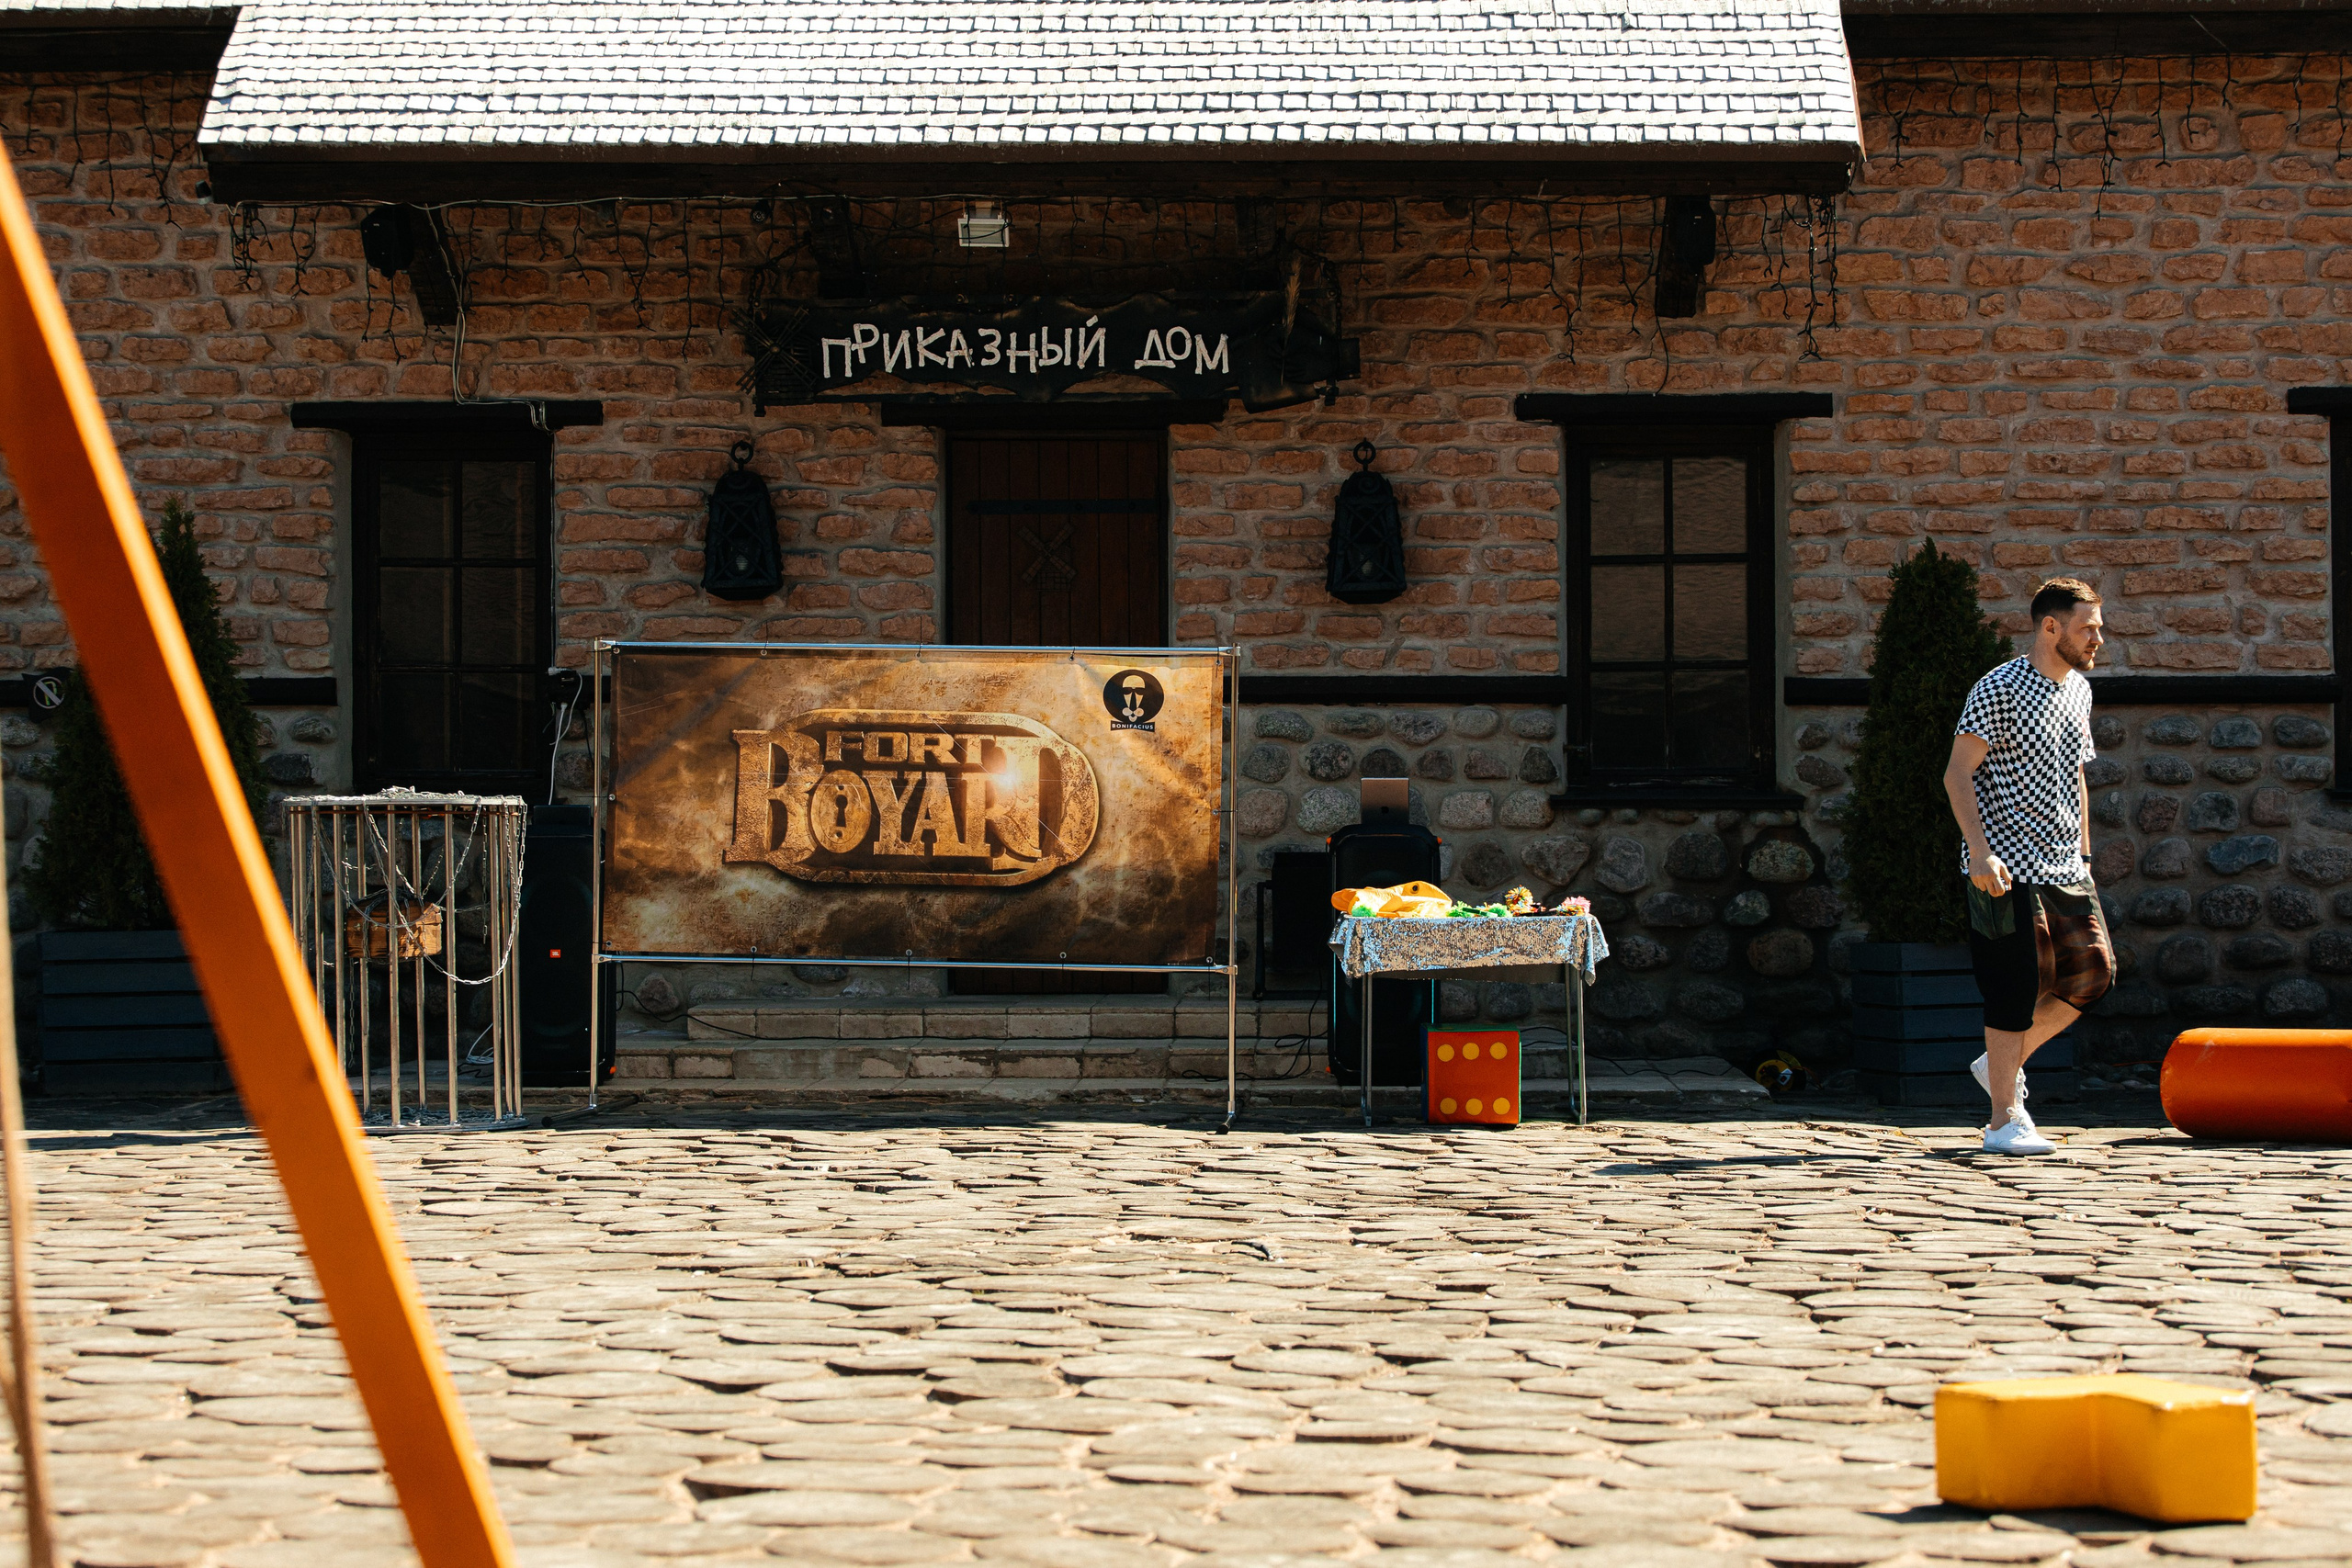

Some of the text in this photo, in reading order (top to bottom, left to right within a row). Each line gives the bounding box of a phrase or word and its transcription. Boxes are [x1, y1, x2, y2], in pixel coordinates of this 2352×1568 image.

[822, 315, 1229, 378] ПРИКАЗНЫЙ ДОМ
[825, 730, 996, 765] FORT
[723, 726, 1099, 884] BOYARD
